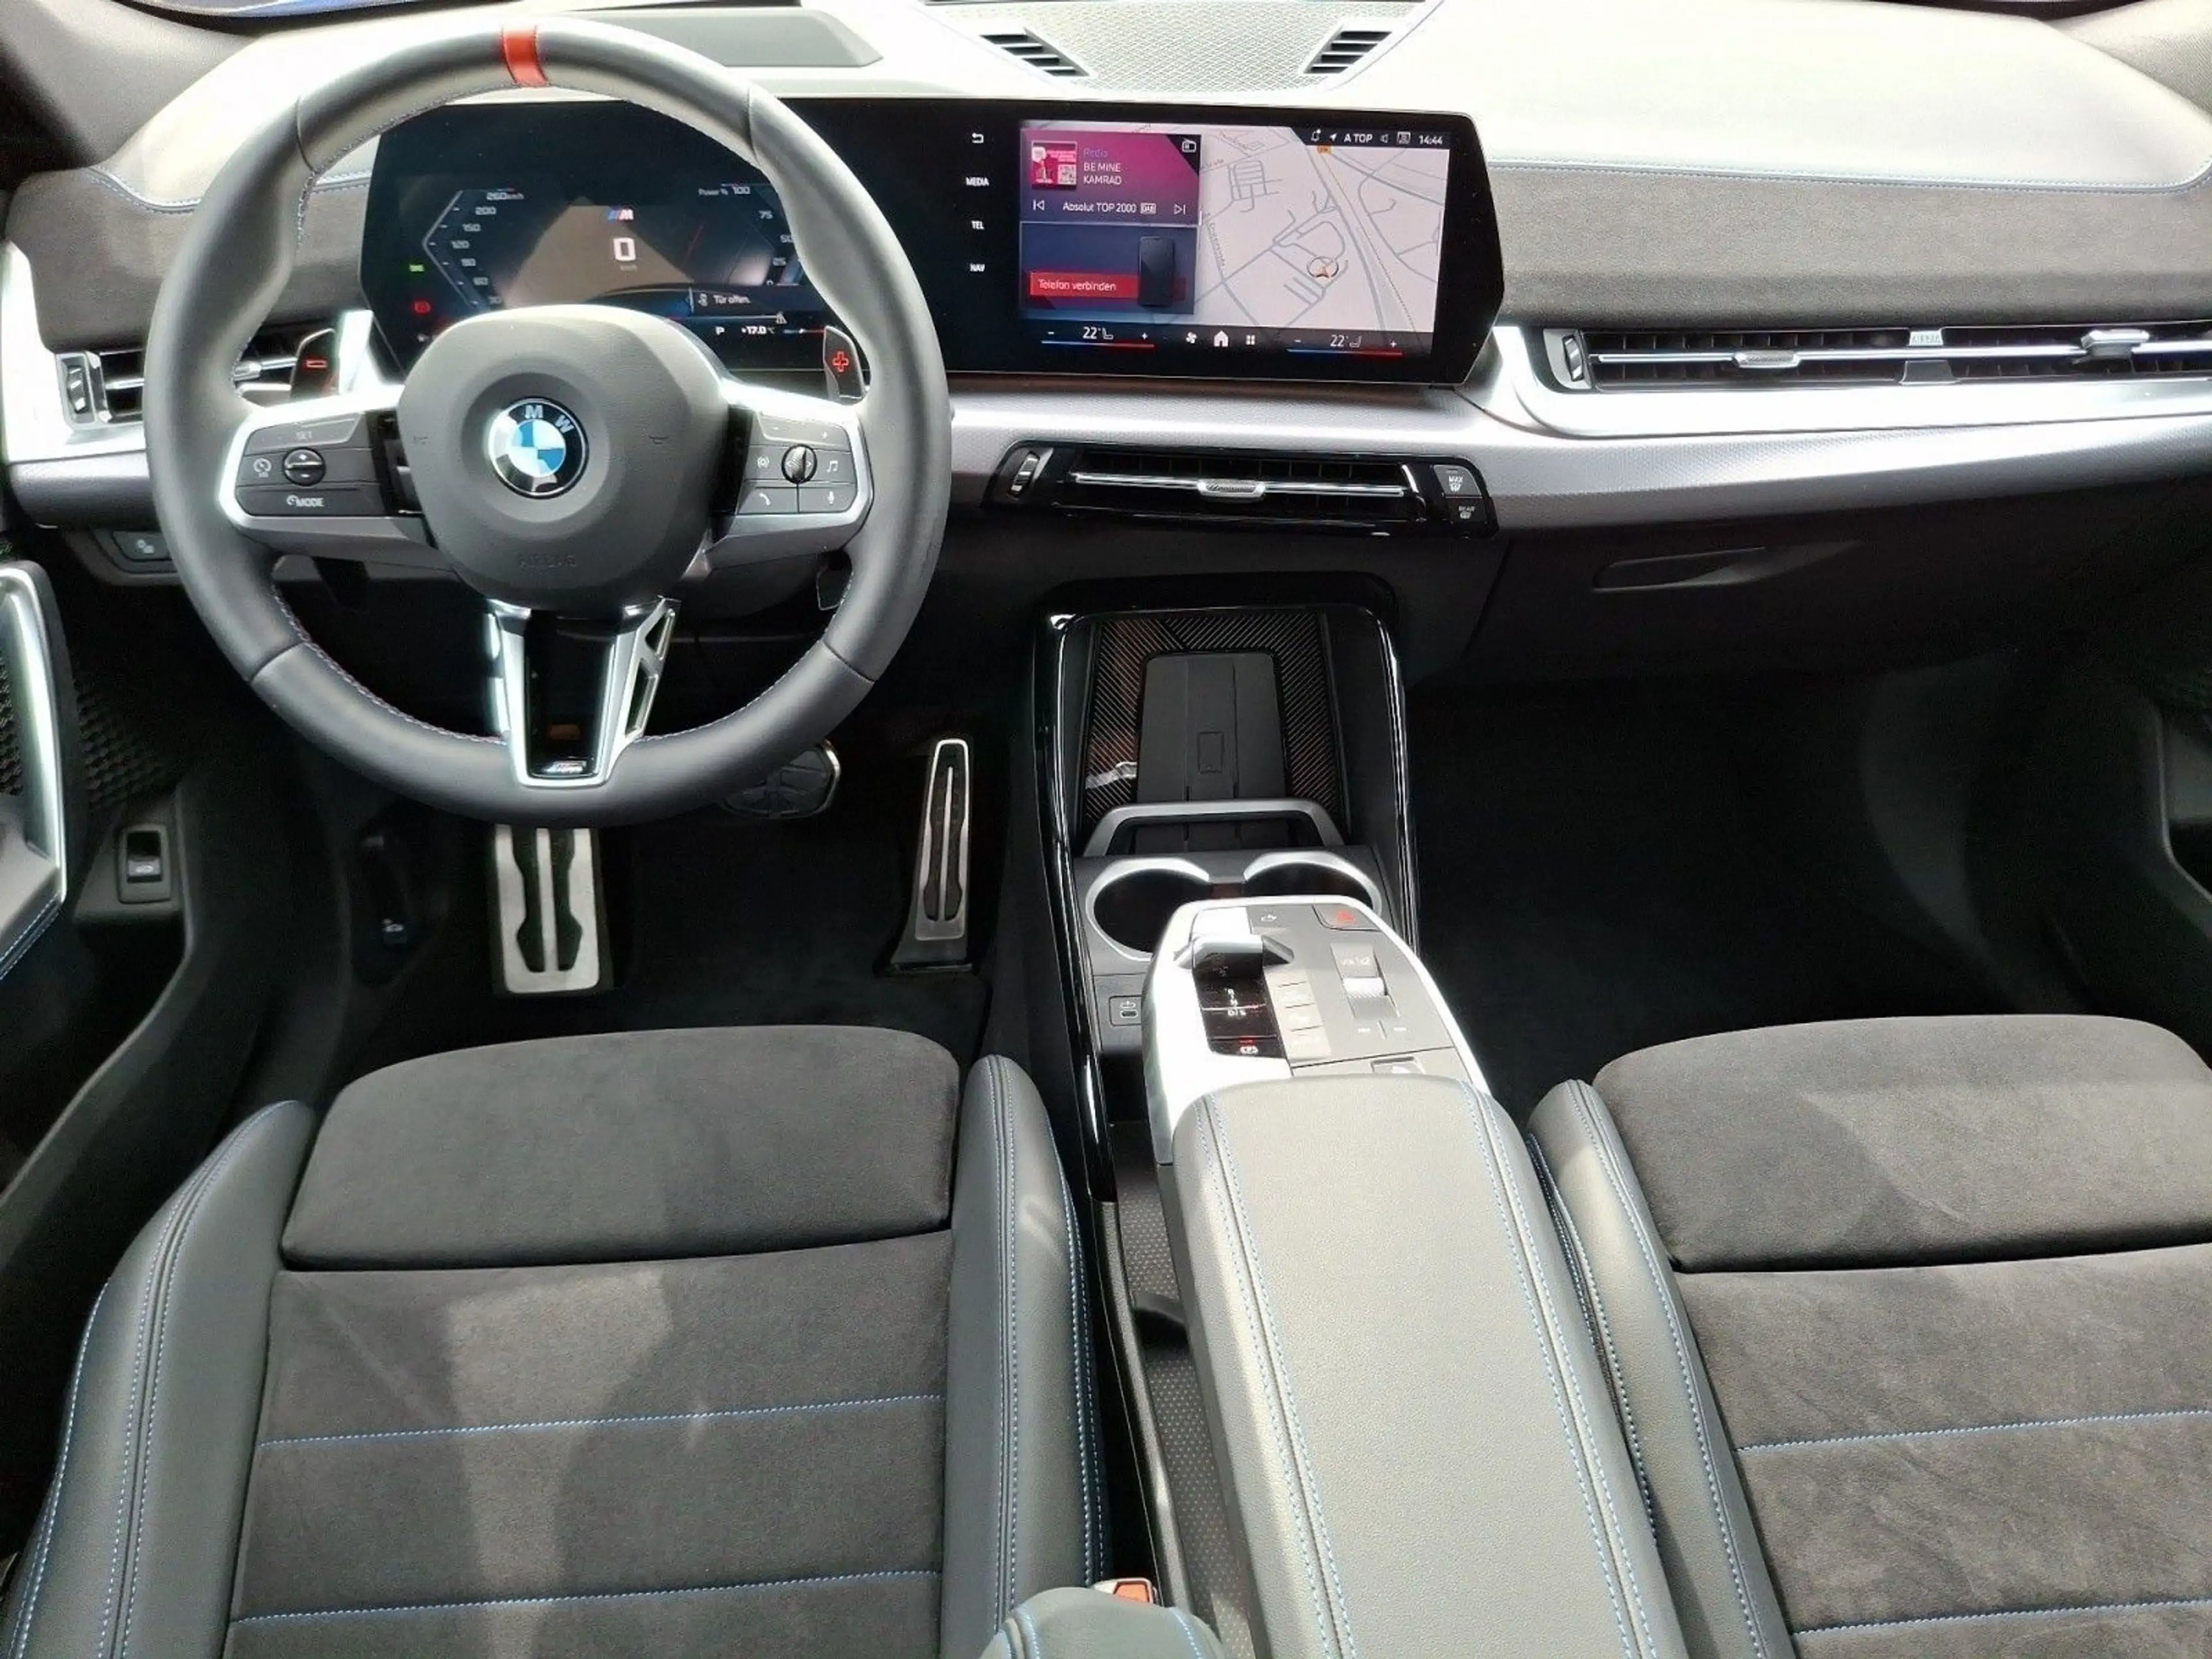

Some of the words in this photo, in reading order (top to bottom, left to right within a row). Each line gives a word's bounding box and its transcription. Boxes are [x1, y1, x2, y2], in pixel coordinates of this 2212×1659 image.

[1354, 134, 1372, 143] TOP
[1419, 135, 1442, 145] 14:44
[1084, 162, 1095, 172] BE
[1097, 162, 1120, 172] MINE
[966, 177, 989, 186] MEDIA
[1084, 175, 1122, 185] KAMRAD
[734, 186, 751, 195] 100
[1063, 202, 1094, 212] Absolut
[1096, 203, 1115, 212] TOP
[1116, 203, 1137, 213] 2000
[759, 210, 773, 219] 75
[971, 220, 984, 230] TEL
[613, 237, 637, 261] 0
[970, 263, 985, 272] NAV
[1038, 279, 1070, 289] Telefon
[1071, 281, 1116, 291] verbinden
[715, 326, 725, 335] P
[296, 497, 324, 507] MODE
